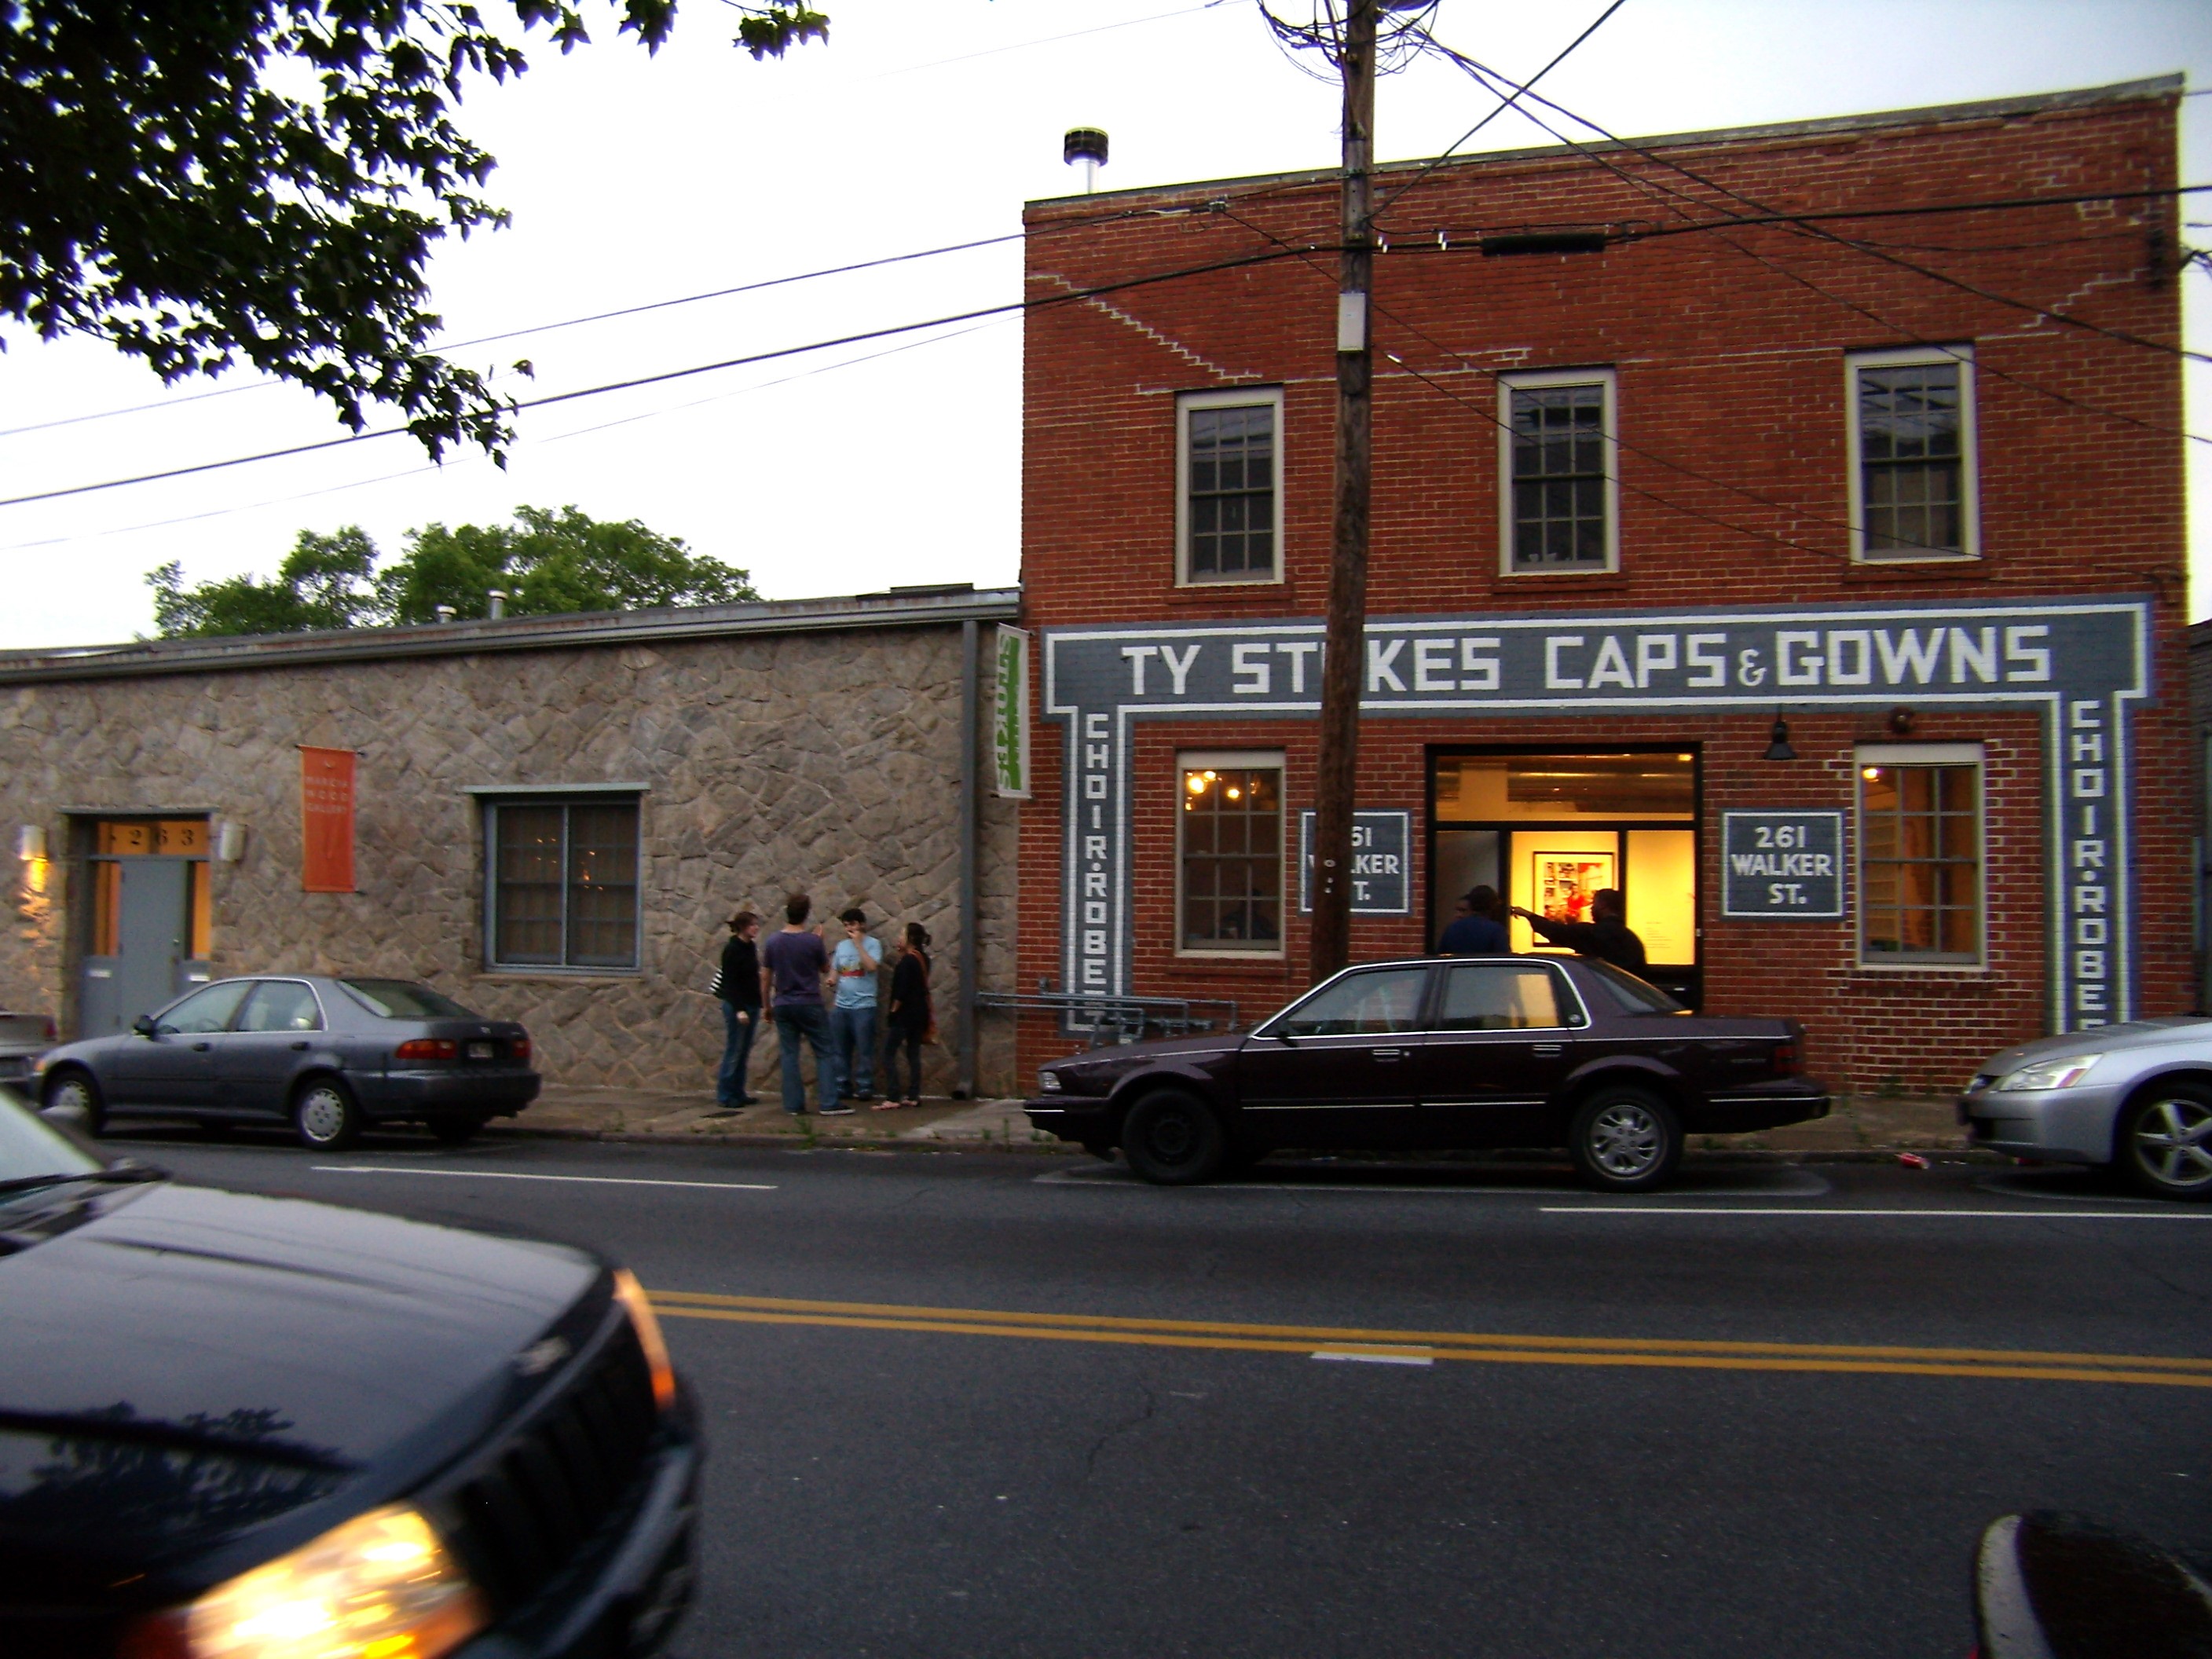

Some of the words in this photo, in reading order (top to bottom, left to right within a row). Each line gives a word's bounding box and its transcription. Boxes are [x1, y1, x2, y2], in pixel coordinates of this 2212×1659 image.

[1121, 644, 1201, 695] TY
[1232, 636, 1501, 694] STKES
[1545, 633, 1726, 689] CAPS
[1738, 649, 1766, 687] &
[1775, 625, 2051, 687] GOWNS
[1755, 826, 1806, 848] 261
[1730, 854, 1833, 876] WALKER
[1768, 884, 1807, 904] ST.
